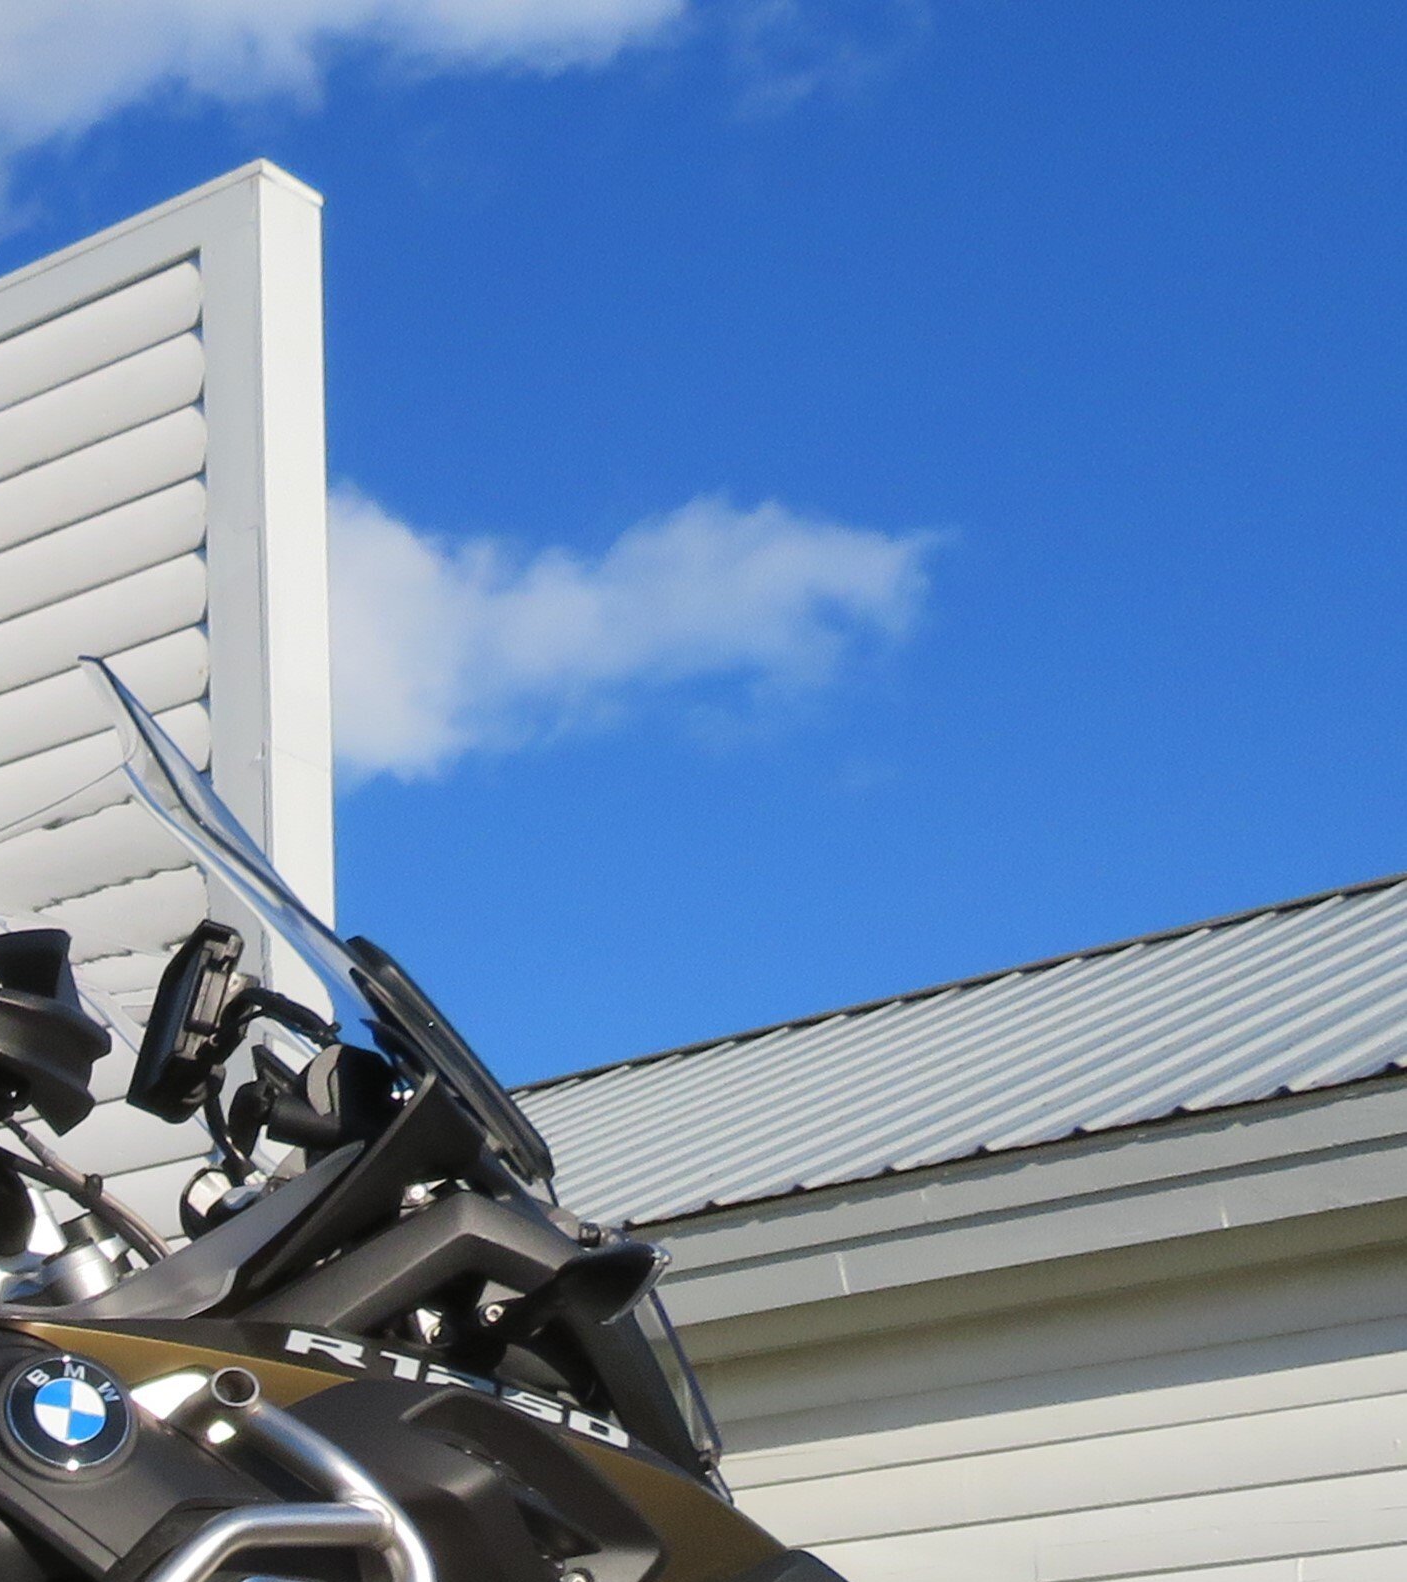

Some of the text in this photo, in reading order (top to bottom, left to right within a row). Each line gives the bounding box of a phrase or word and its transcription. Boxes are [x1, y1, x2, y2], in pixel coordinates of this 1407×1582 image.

[26, 1362, 122, 1403] BMW
[284, 1328, 631, 1449] R 1250
